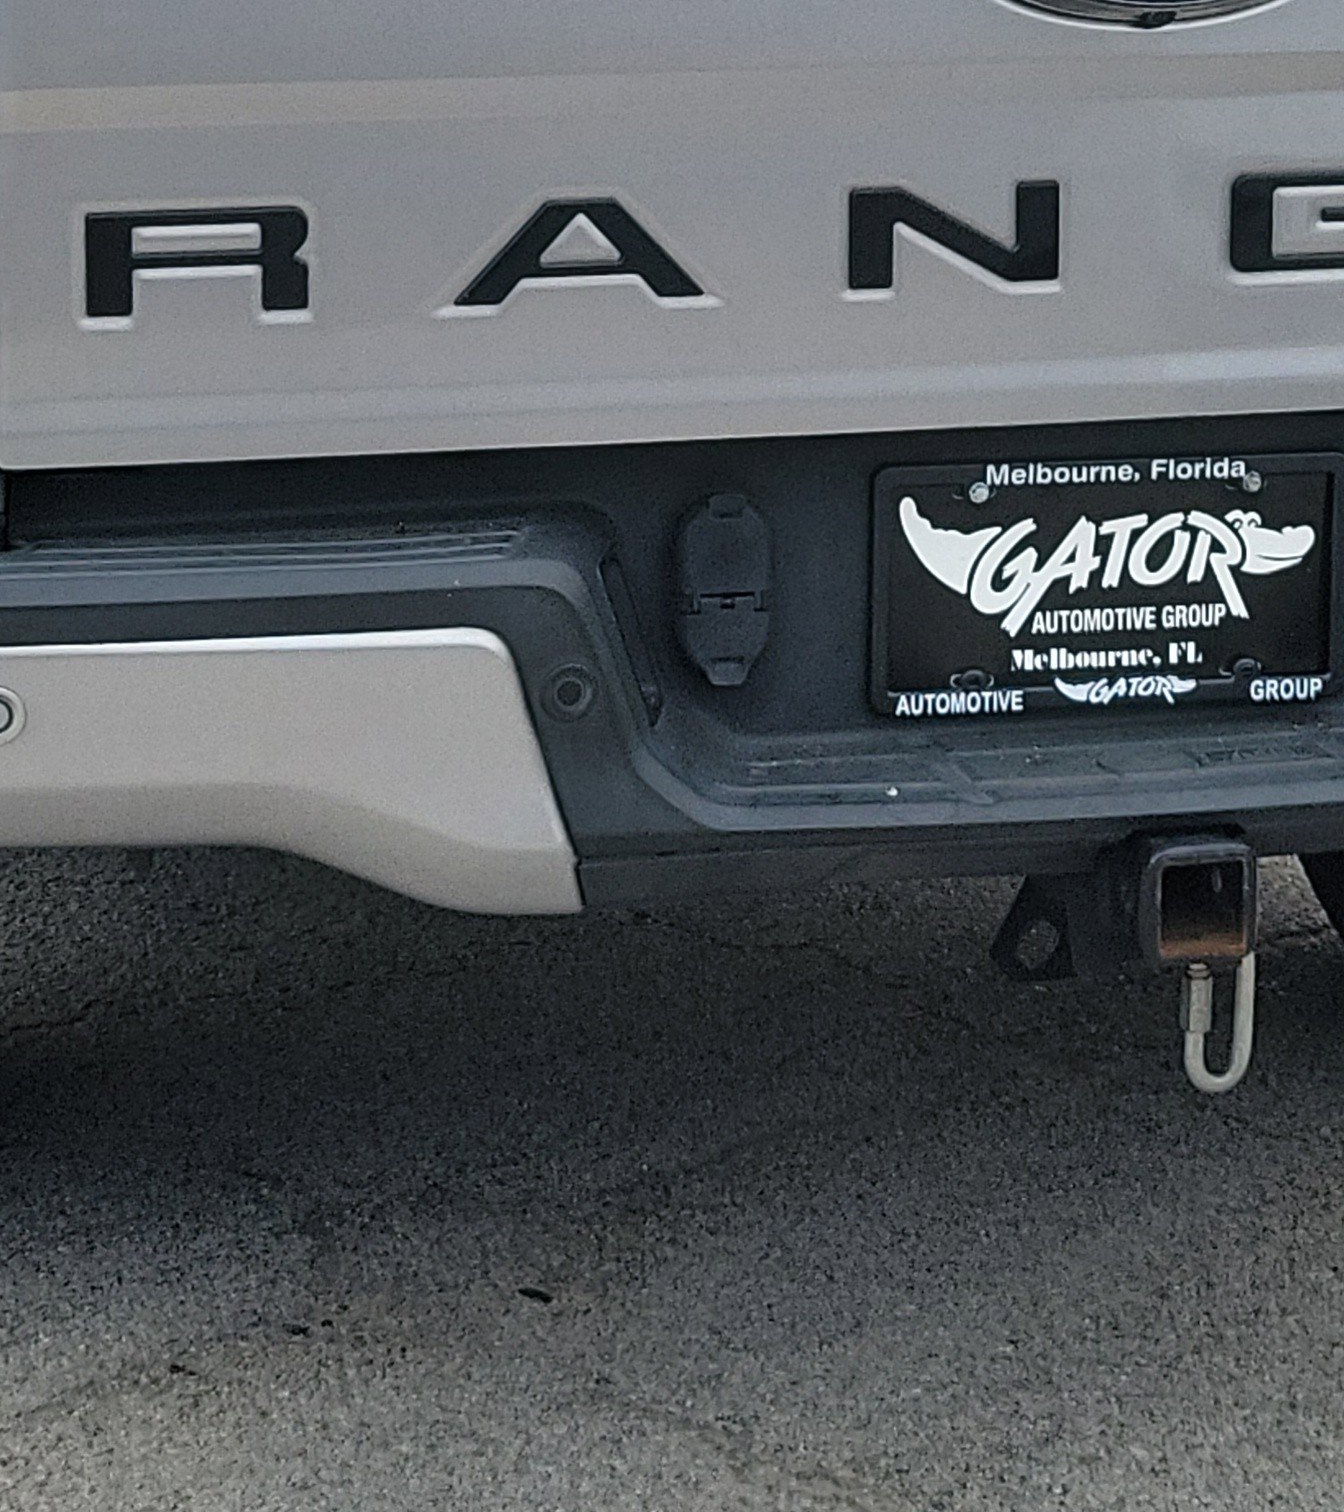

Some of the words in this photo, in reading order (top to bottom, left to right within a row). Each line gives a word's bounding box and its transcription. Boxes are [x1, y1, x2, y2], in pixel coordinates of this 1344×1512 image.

[986, 463, 1140, 486] Melbourne,
[1151, 457, 1246, 481] Florida
[970, 510, 1250, 637] GATOR
[1031, 607, 1157, 635] AUTOMOTIVE
[1161, 603, 1227, 629] GROUP
[1168, 641, 1203, 665] FL
[895, 690, 1024, 717] AUTOMOTIVE
[1087, 675, 1175, 705] GATOR
[1251, 678, 1322, 702] GROUP
